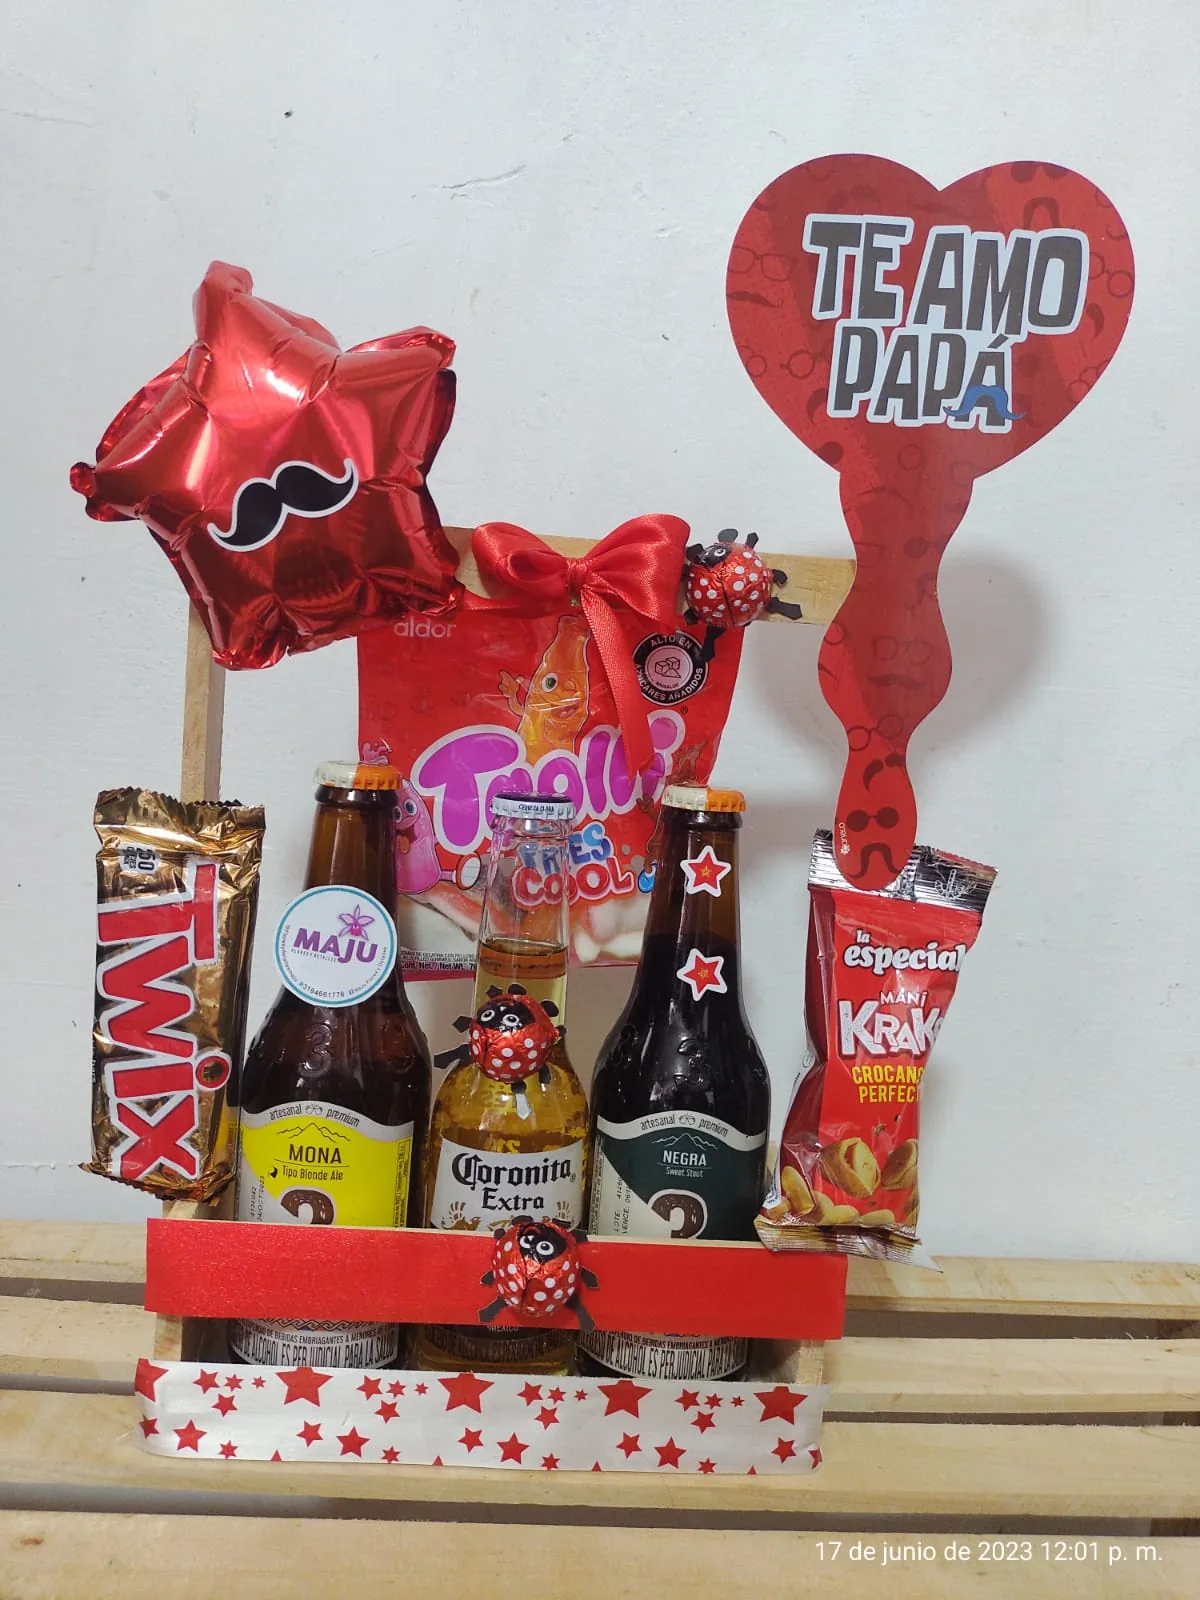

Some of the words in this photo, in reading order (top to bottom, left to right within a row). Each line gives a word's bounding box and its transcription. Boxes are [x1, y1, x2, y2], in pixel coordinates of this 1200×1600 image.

[804, 214, 913, 321] TE
[909, 226, 1088, 342] AMO
[828, 321, 1013, 432] PAPÁ
[393, 615, 457, 638] aldor
[650, 635, 676, 647] ALTO
[678, 636, 693, 650] EN
[512, 857, 635, 908] COOL
[293, 927, 378, 964] MAJU
[856, 930, 870, 943] la
[269, 1104, 302, 1121] artesanal
[325, 1108, 360, 1127] premium
[640, 1114, 676, 1130] artesanal
[698, 1118, 729, 1138] premium
[289, 1144, 342, 1164] MONA
[662, 1150, 707, 1166] NEGRA
[282, 1165, 298, 1178] Tipo
[300, 1168, 328, 1181] Blonde
[330, 1170, 344, 1181] Ale
[451, 1153, 571, 1190] Coronita
[666, 1167, 685, 1177] Sweet
[686, 1168, 704, 1178] Stout
[482, 1187, 544, 1211] Extra
[274, 1331, 298, 1343] BEBIDAS
[299, 1335, 344, 1345] EMBRIAGANTES
[345, 1335, 350, 1343] A
[252, 1333, 278, 1366] ALCOHOL
[281, 1343, 290, 1366] ES
[292, 1345, 341, 1368] PERJUDICIAL
[344, 1342, 363, 1368] PARA
[365, 1339, 374, 1367] LA
[615, 1339, 647, 1374] ALCOHOL
[648, 1348, 658, 1377] ES
[660, 1350, 704, 1379] PERJUDICIAL
